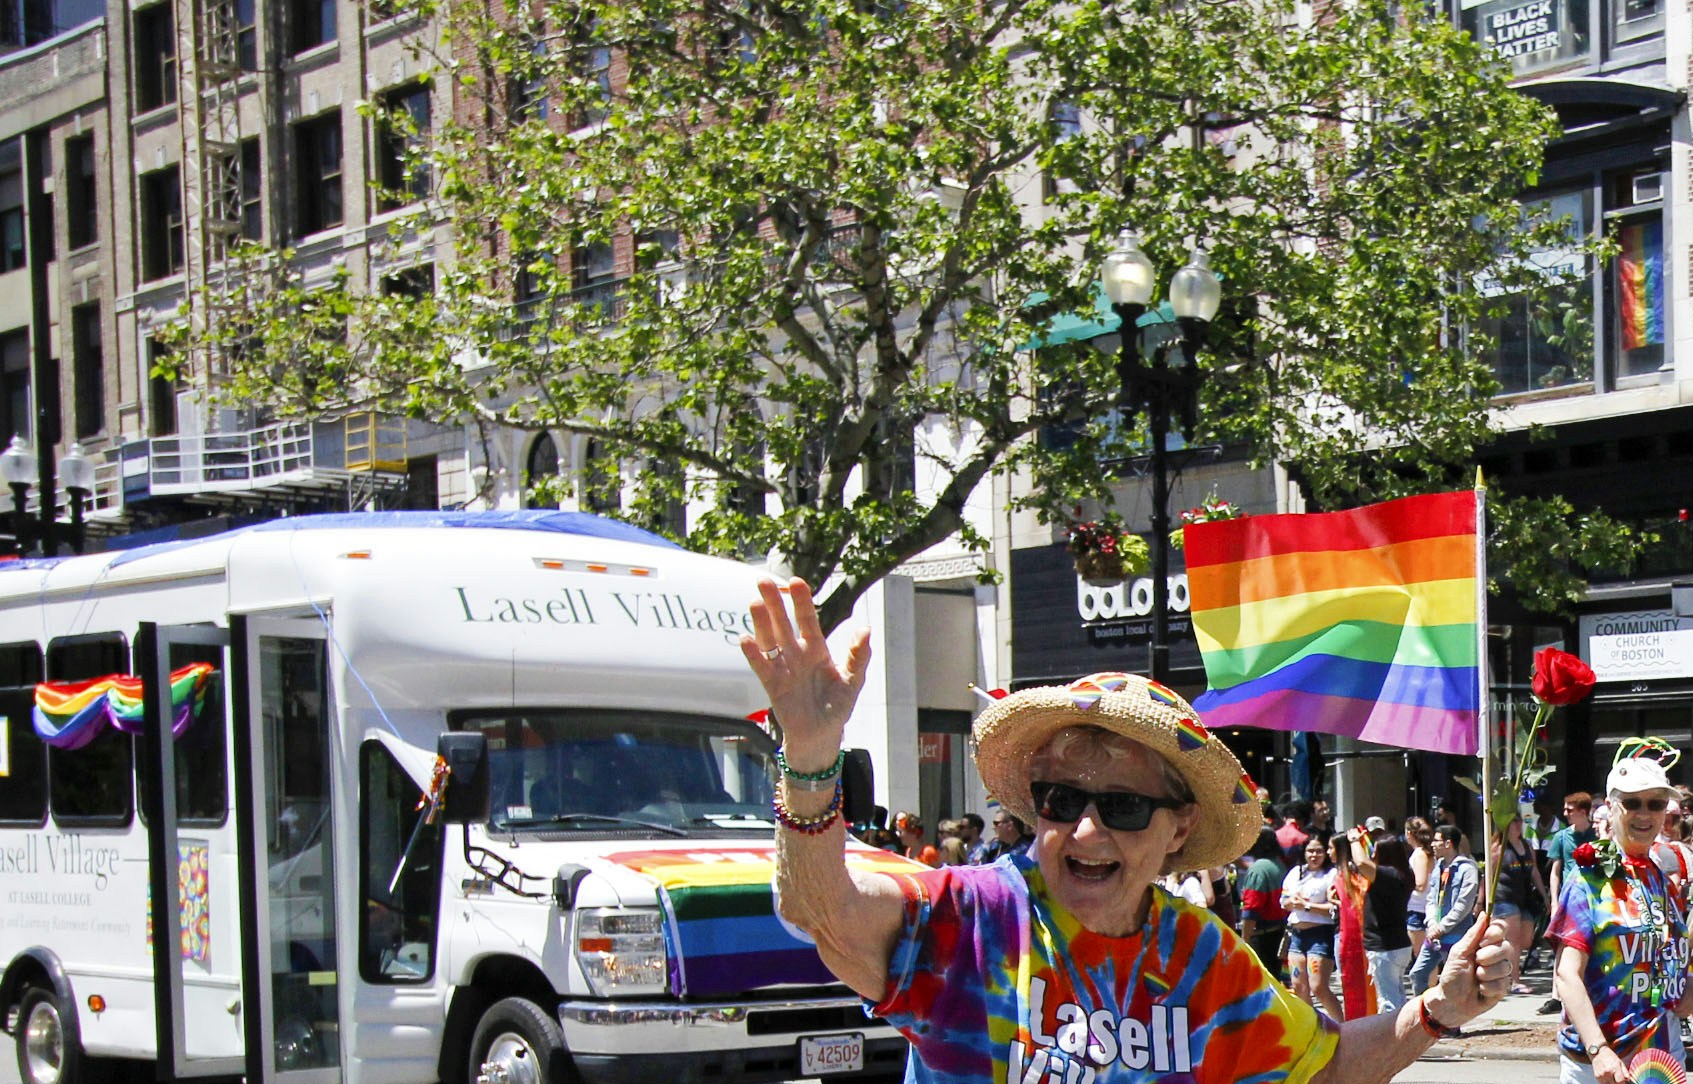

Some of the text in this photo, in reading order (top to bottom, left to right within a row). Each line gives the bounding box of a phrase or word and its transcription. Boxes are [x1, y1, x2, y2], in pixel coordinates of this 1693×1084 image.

[1492, 1, 1552, 29] BLACK
[1497, 17, 1549, 44] LIVES
[452, 586, 758, 647] Lasell Village
[1595, 619, 1680, 636] COMMUNITY
[1615, 635, 1660, 649] CHURCH
[1621, 648, 1665, 661] BOSTON
[46, 832, 120, 891] Village
[19, 891, 51, 905] LASELL
[51, 893, 93, 906] COLLEGE
[1029, 976, 1191, 1074] Lasell
[817, 1043, 860, 1064] 42509
